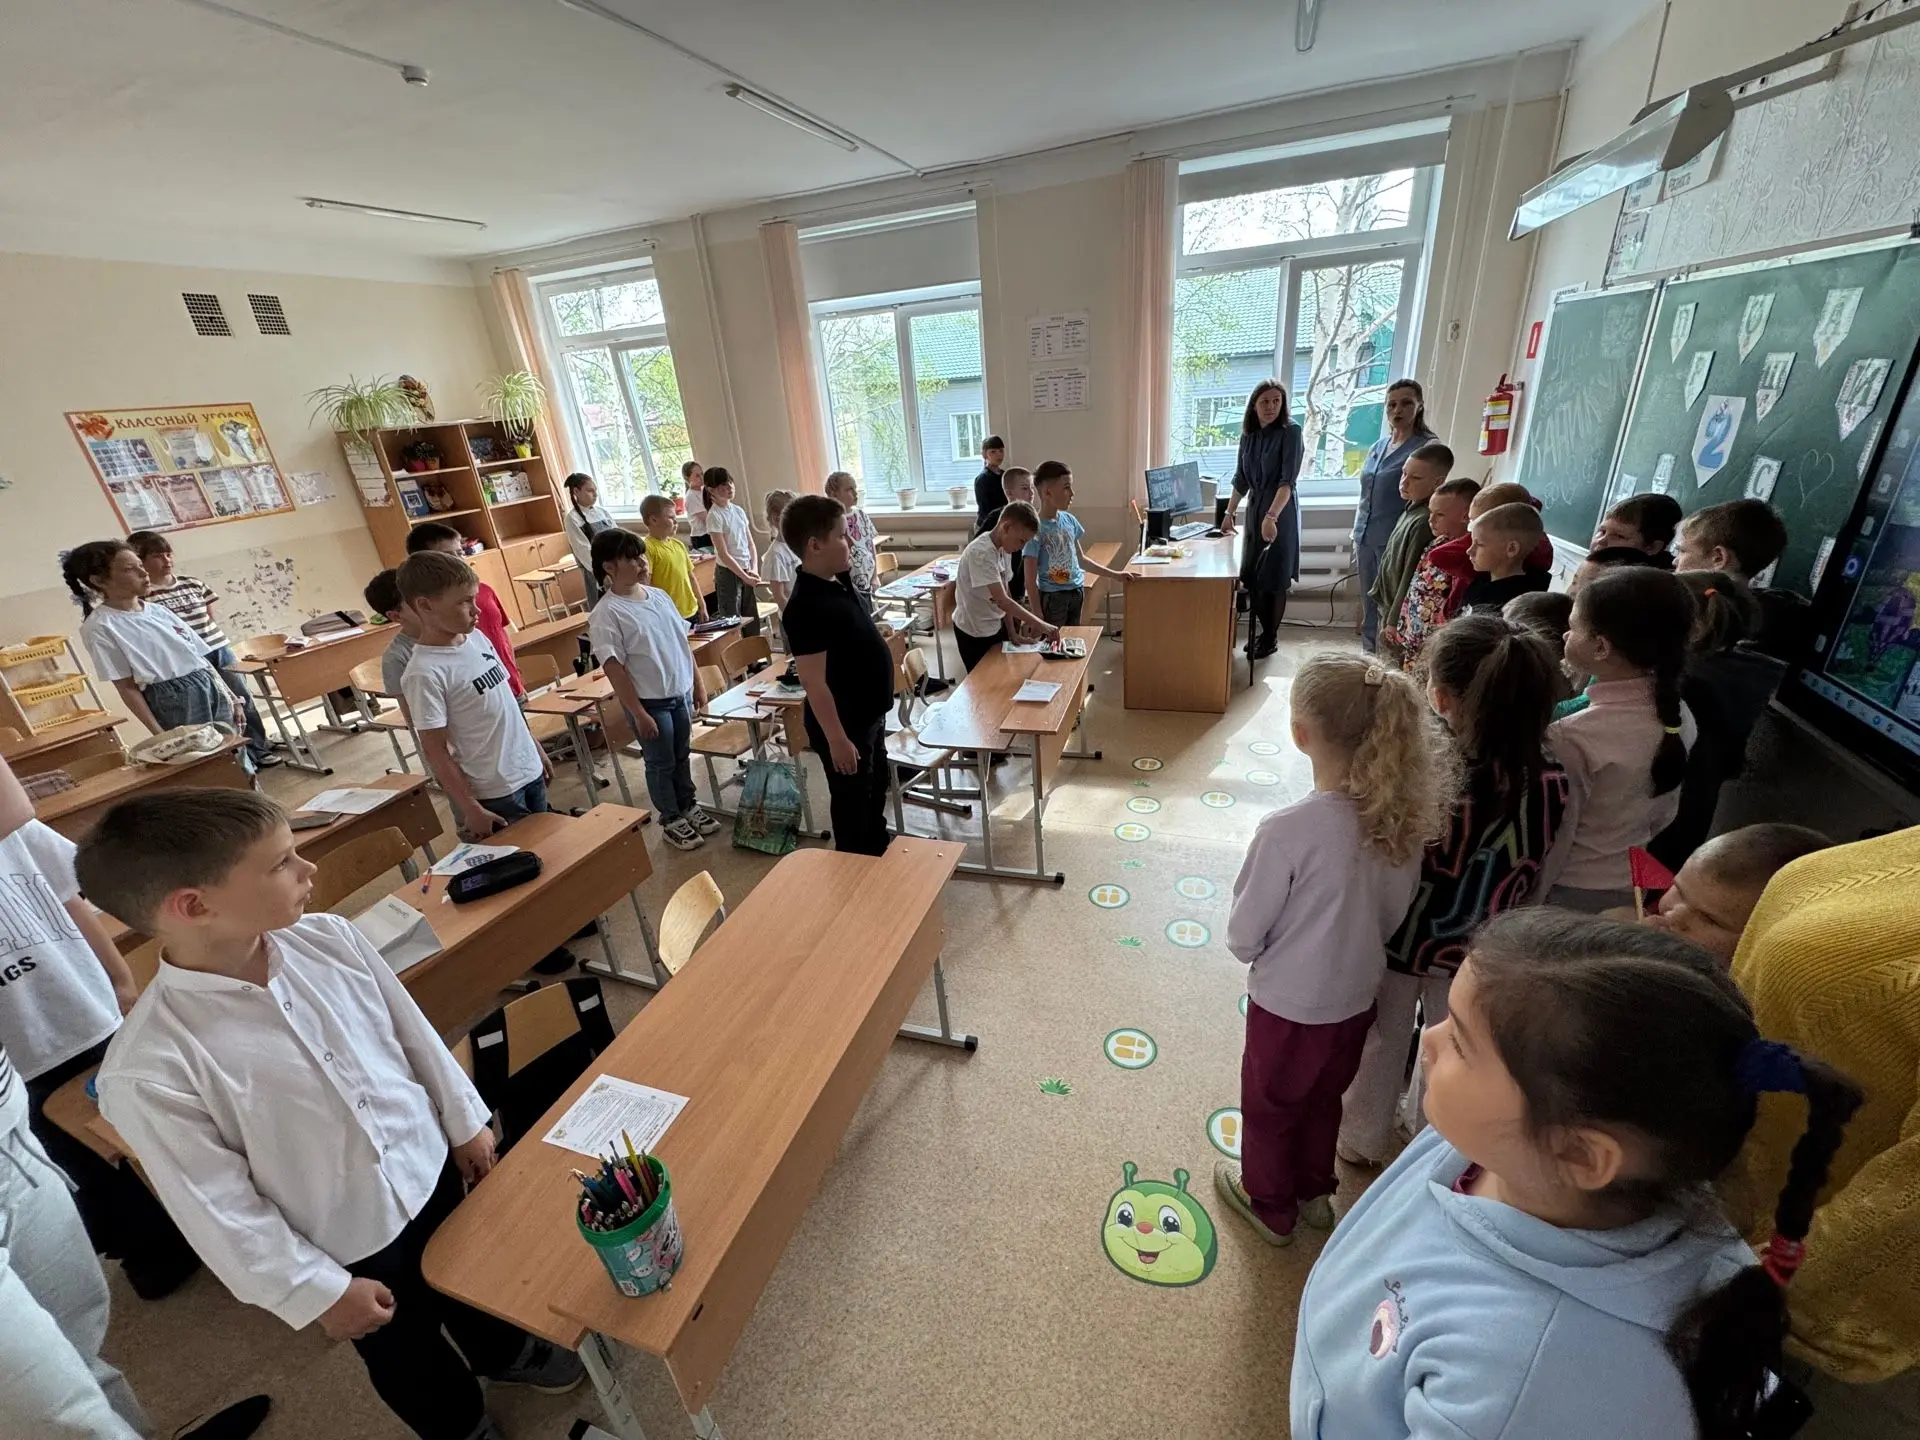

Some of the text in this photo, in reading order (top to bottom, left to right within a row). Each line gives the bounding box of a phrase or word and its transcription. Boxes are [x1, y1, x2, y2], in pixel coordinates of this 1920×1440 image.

[115, 413, 198, 429] КЛАССНЫЙ
[1697, 408, 1732, 469] 2
[0, 956, 36, 987] GS
